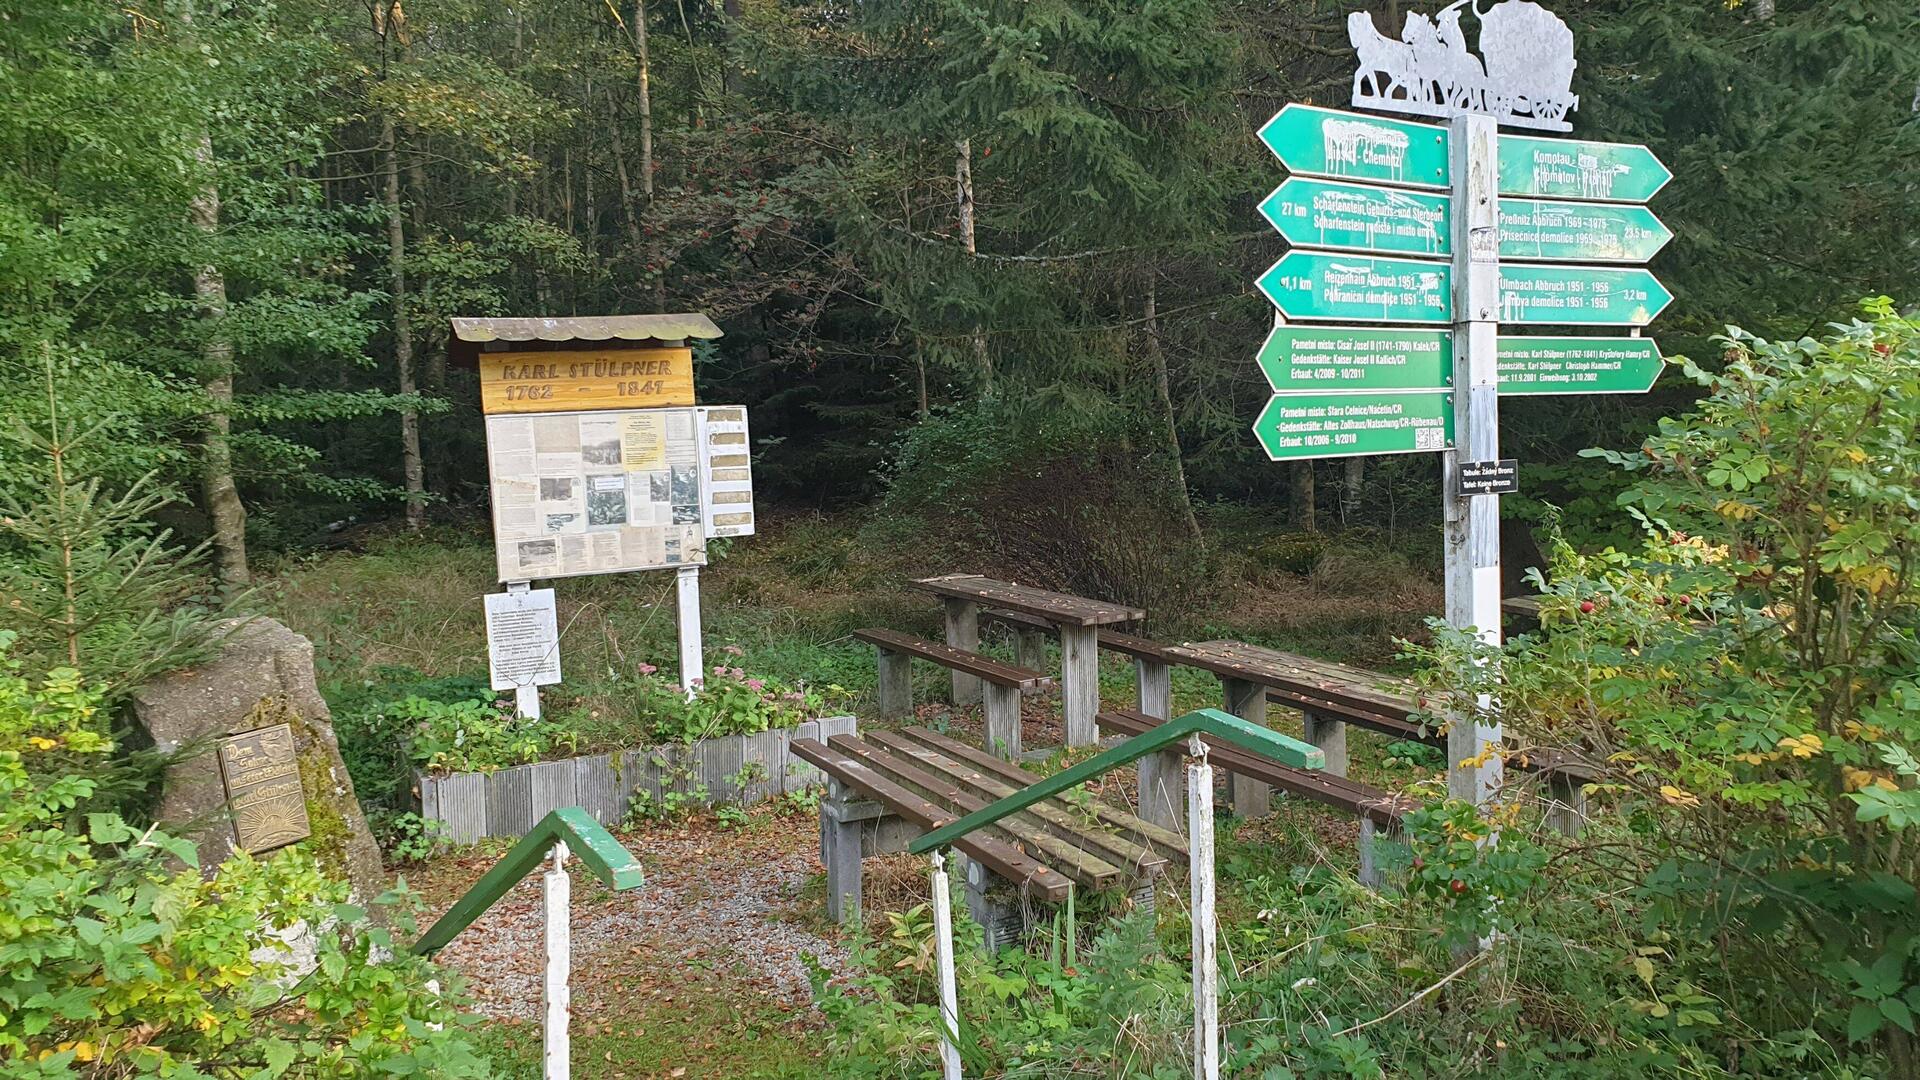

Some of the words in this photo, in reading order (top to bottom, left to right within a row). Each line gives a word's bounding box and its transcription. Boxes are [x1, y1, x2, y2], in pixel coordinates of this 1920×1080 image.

[1363, 149, 1401, 168] Chemnitz
[1533, 149, 1570, 164] Komotau
[1282, 201, 1293, 217] 27
[1294, 203, 1307, 218] km
[1412, 207, 1444, 222] Sterbeort
[1313, 214, 1365, 232] Scharfenstein
[1500, 212, 1531, 226] Preßnitz
[1532, 214, 1562, 227] Abbruch
[1564, 216, 1582, 228] 1969
[1541, 231, 1574, 244] demolice
[1576, 233, 1593, 244] 1969
[1641, 227, 1652, 239] km
[1299, 276, 1312, 290] km
[1367, 273, 1396, 288] Abbruch
[1398, 275, 1415, 290] 1951
[1500, 277, 1533, 290] Ulmbach
[1535, 279, 1565, 292] Abbruch
[1567, 280, 1584, 292] 1951
[1592, 282, 1609, 293] 1956
[1365, 290, 1398, 306] demolice
[1400, 293, 1417, 307] 1951
[1424, 294, 1441, 308] 1956
[1531, 295, 1565, 307] demolice
[1566, 297, 1583, 308] 1951
[1591, 298, 1609, 309] 1956
[1624, 289, 1635, 301] 3,2
[1636, 290, 1647, 301] km
[1353, 340, 1369, 351] Josef
[1370, 340, 1375, 351] II
[1376, 341, 1412, 352] (1741-1790)
[1291, 353, 1332, 364] Gedenkstätte:
[1333, 354, 1352, 365] Kaiser
[1353, 354, 1369, 365] Josef
[1370, 354, 1375, 365] II
[1531, 349, 1542, 358] Karl
[1543, 349, 1565, 360] Stülpner
[503, 364, 560, 380] KARL
[569, 358, 672, 378] STÜLPNER
[1528, 362, 1539, 370] Karl
[1540, 361, 1562, 371] Stülpner
[1565, 361, 1590, 371] Christoph
[1291, 368, 1313, 379] Erbaut:
[1314, 368, 1336, 380] 4/2009
[1341, 368, 1365, 379] 10/2011
[506, 384, 554, 400] 1762
[617, 380, 664, 396] 1841
[1280, 421, 1323, 433] Gedenkstätte:
[1323, 420, 1340, 431] Altes
[1280, 435, 1303, 447] Erbaut:
[1304, 434, 1330, 446] 10/2006
[1334, 432, 1357, 445] 9/2010
